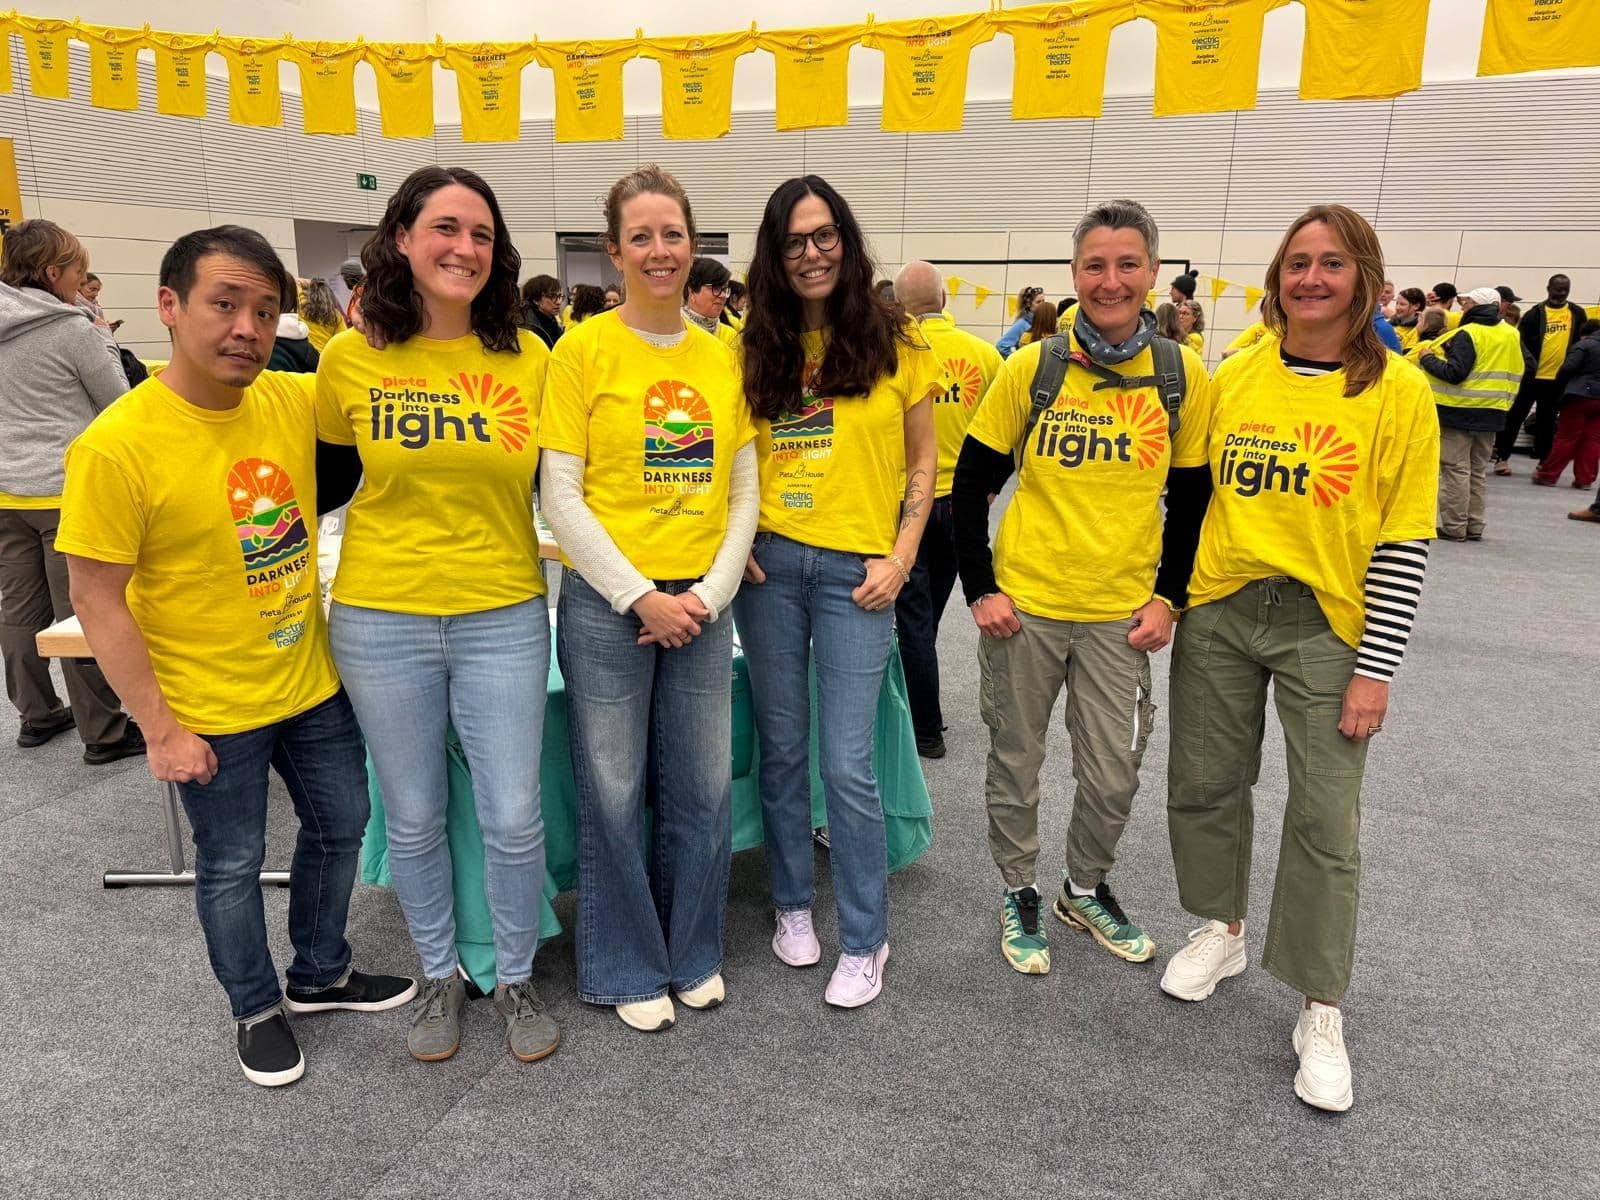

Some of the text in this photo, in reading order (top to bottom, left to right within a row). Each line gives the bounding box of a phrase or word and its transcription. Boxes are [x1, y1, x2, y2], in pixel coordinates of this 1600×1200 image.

[382, 376, 427, 389] pieta
[369, 388, 461, 405] Darkness
[1056, 394, 1089, 409] pieta
[401, 403, 429, 412] into
[1044, 409, 1114, 425] Darkness
[371, 404, 491, 449] light
[1065, 423, 1087, 433] into
[1239, 420, 1276, 434] pieta
[772, 438, 832, 453] DARKNESS
[1036, 422, 1131, 468] light
[1225, 433, 1297, 452] Darkness
[772, 448, 832, 464] INTO LIGHT
[1243, 449, 1266, 460] into
[644, 471, 712, 483] DARKNESS
[1220, 449, 1310, 497] light
[644, 484, 713, 496] INTO LIGHT
[780, 490, 813, 501] electric
[682, 508, 705, 516] House
[249, 582, 281, 598] INTO
[260, 609, 281, 619] Pieta
